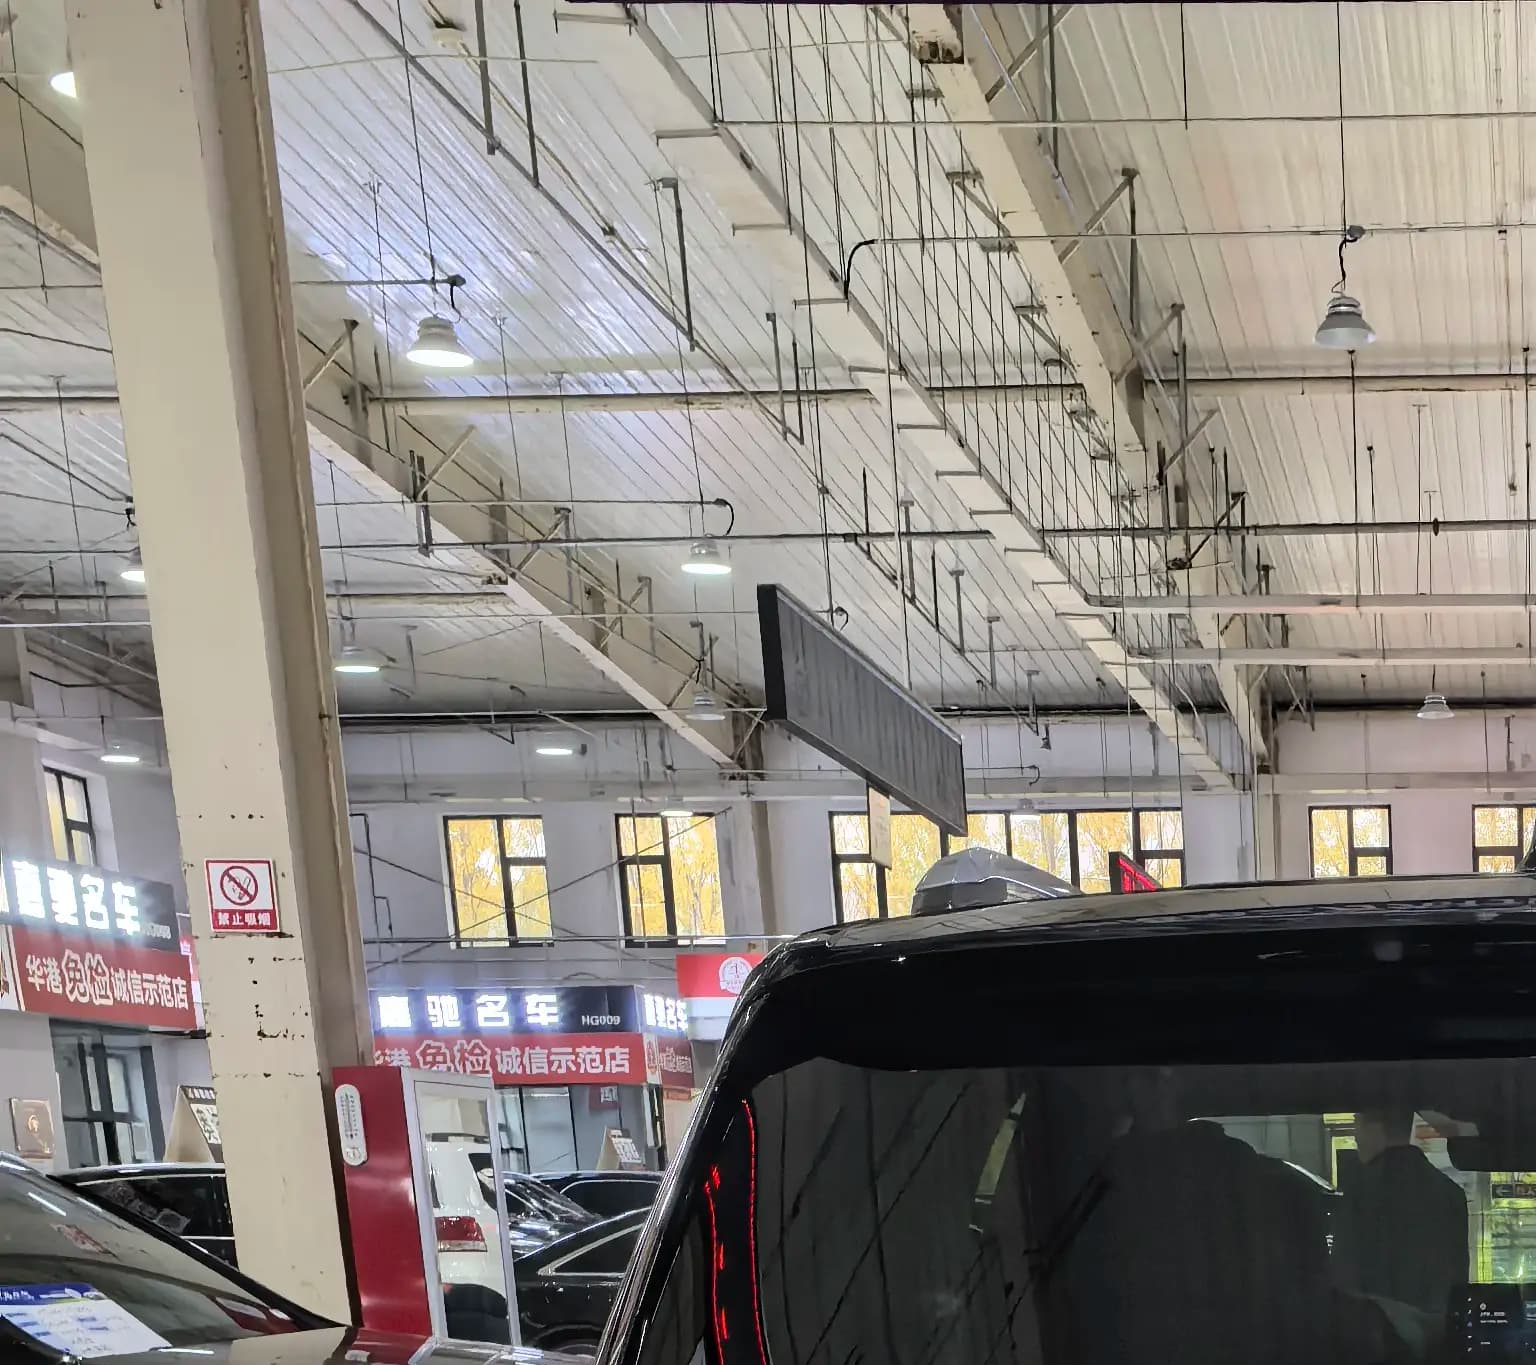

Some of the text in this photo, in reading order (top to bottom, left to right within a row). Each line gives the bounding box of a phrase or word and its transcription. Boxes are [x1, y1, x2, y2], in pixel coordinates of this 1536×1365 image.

[218, 912, 271, 926] 禁止吸烟
[25, 949, 189, 1010] 华港免检诚信示范店
[581, 1015, 621, 1025] HG009
